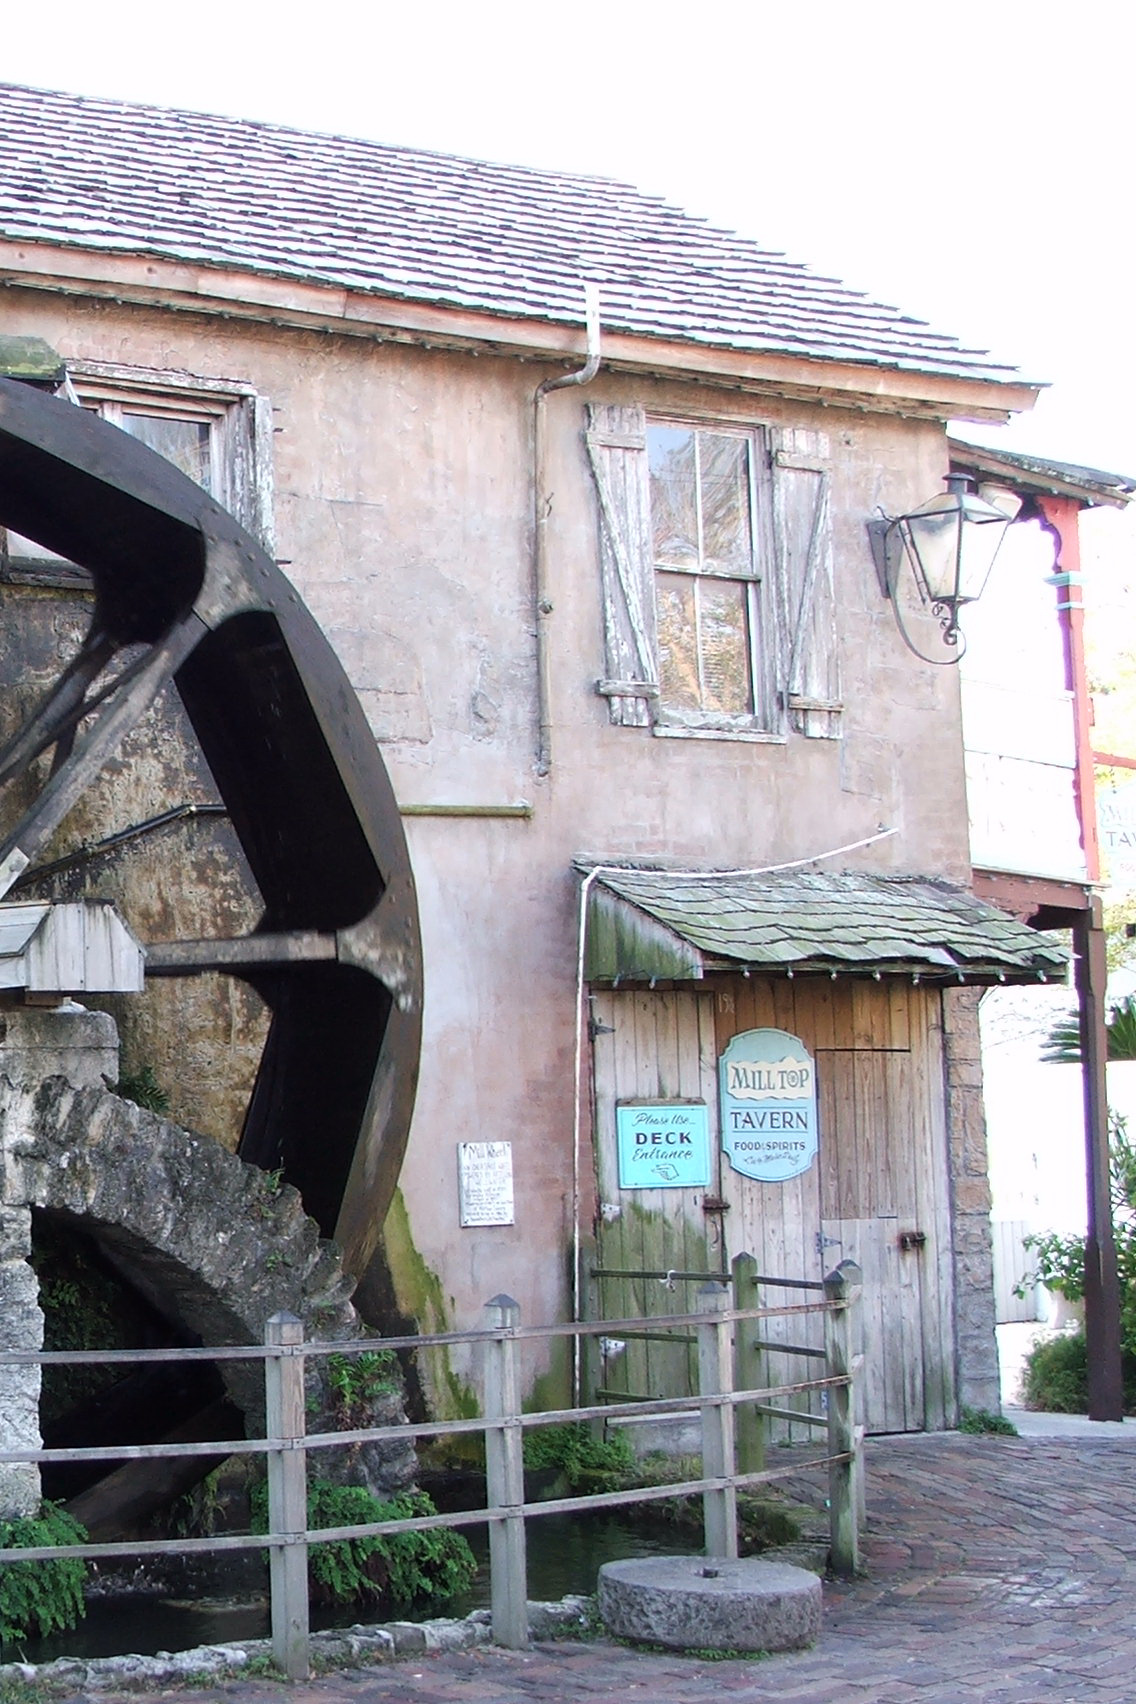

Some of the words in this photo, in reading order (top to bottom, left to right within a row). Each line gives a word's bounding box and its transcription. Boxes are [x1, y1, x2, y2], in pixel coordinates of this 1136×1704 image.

[1105, 831, 1136, 847] TA
[730, 1066, 776, 1091] MILL
[778, 1068, 810, 1090] TOP
[632, 1112, 669, 1127] Please
[730, 1111, 808, 1130] TAVERN
[635, 1132, 693, 1146] DECK
[734, 1141, 761, 1151] FOOD
[766, 1141, 806, 1151] SPIRITS
[632, 1147, 693, 1162] Entrance
